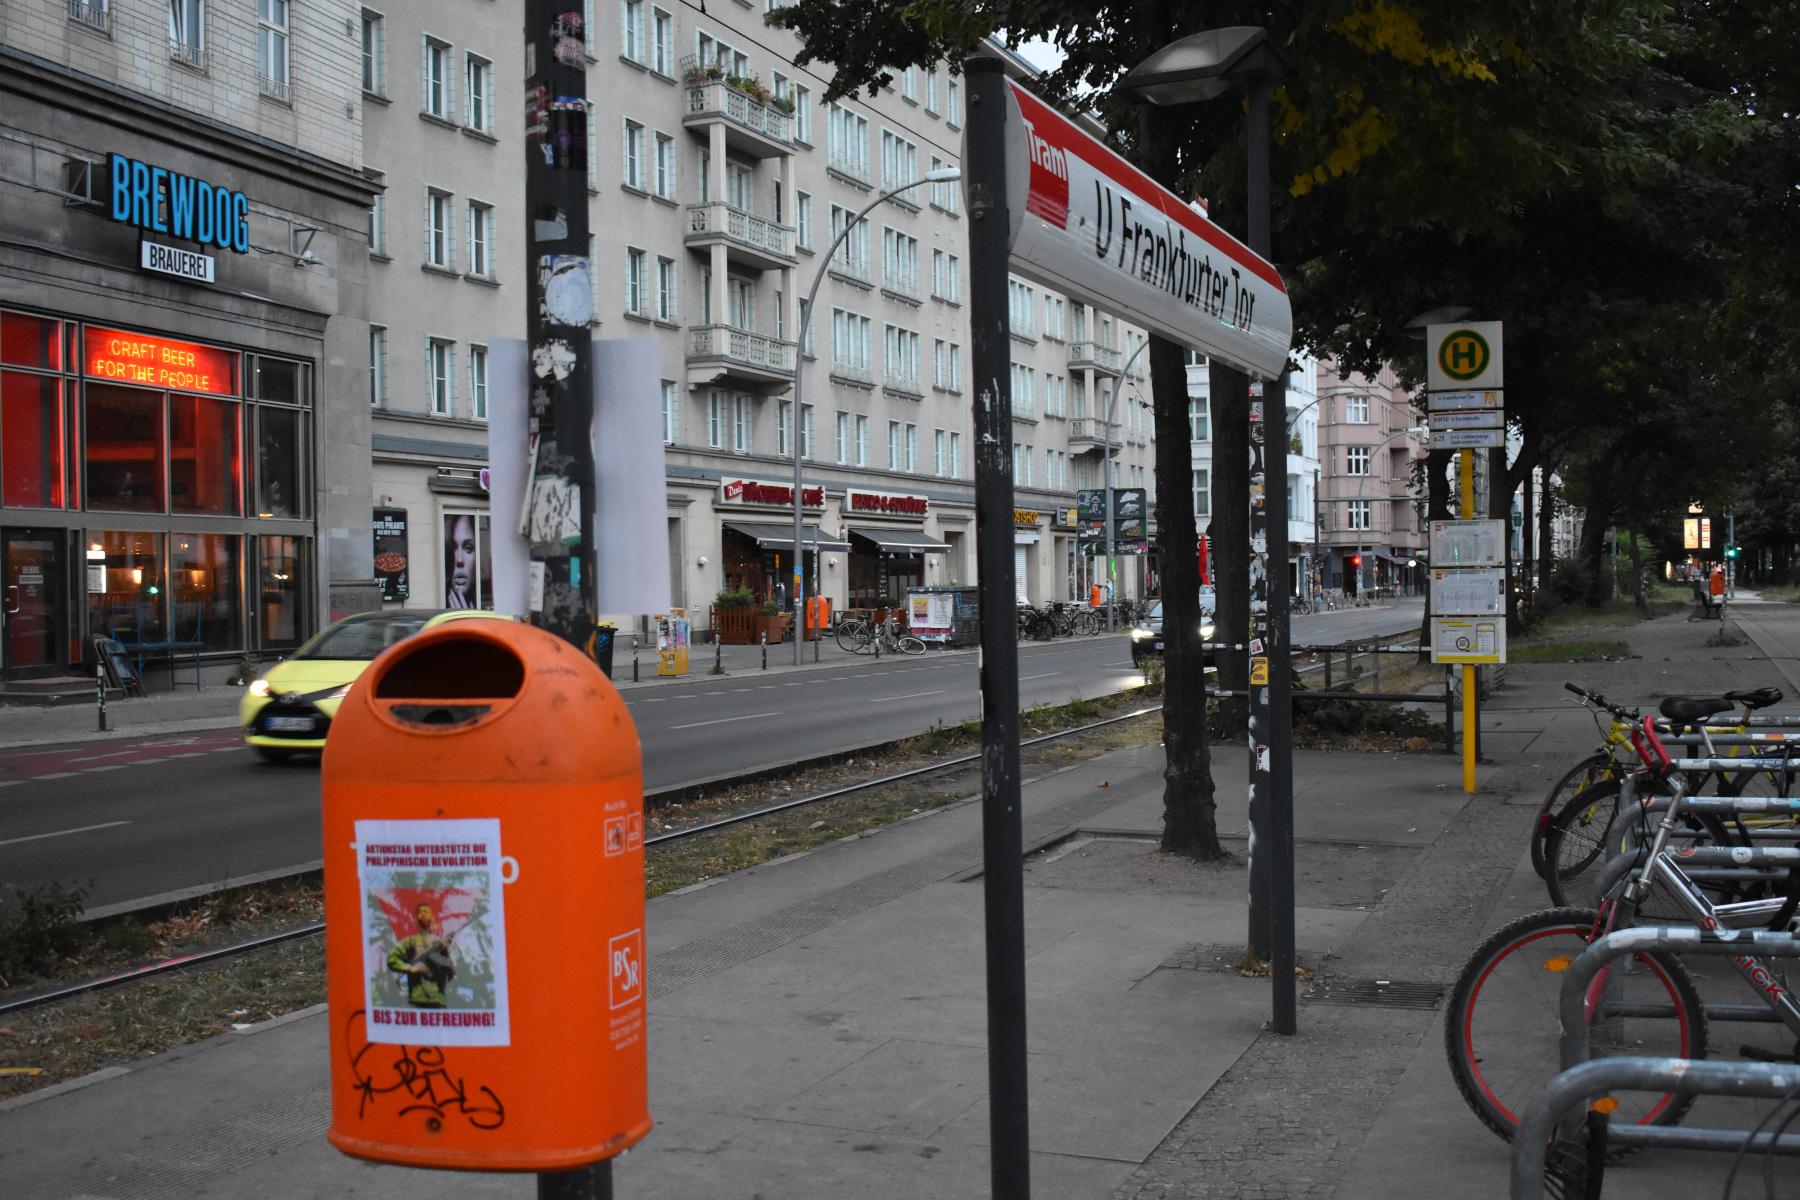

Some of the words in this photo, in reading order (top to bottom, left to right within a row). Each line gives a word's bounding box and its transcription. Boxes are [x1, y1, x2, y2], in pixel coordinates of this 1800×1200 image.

[1024, 118, 1068, 181] Tram
[111, 153, 249, 254] BREWDOG
[150, 245, 208, 279] BRAUEREI
[1095, 178, 1113, 259] U
[1117, 195, 1229, 320] Frankfurter
[1230, 266, 1256, 331] Tor
[111, 339, 157, 360] CRAFT
[162, 347, 195, 368] BEER
[96, 360, 125, 377] FOR
[127, 364, 155, 383] THE
[160, 369, 209, 391] PEOPLE
[366, 855, 429, 867] PHILIPPINISCHE
[431, 855, 488, 867] REVOLUTION
[473, 843, 487, 854] DIE
[613, 947, 640, 991] BSR
[373, 1009, 393, 1024] BIS
[394, 1011, 418, 1026] ZUR
[420, 1011, 496, 1027] BEFREIUNG!
